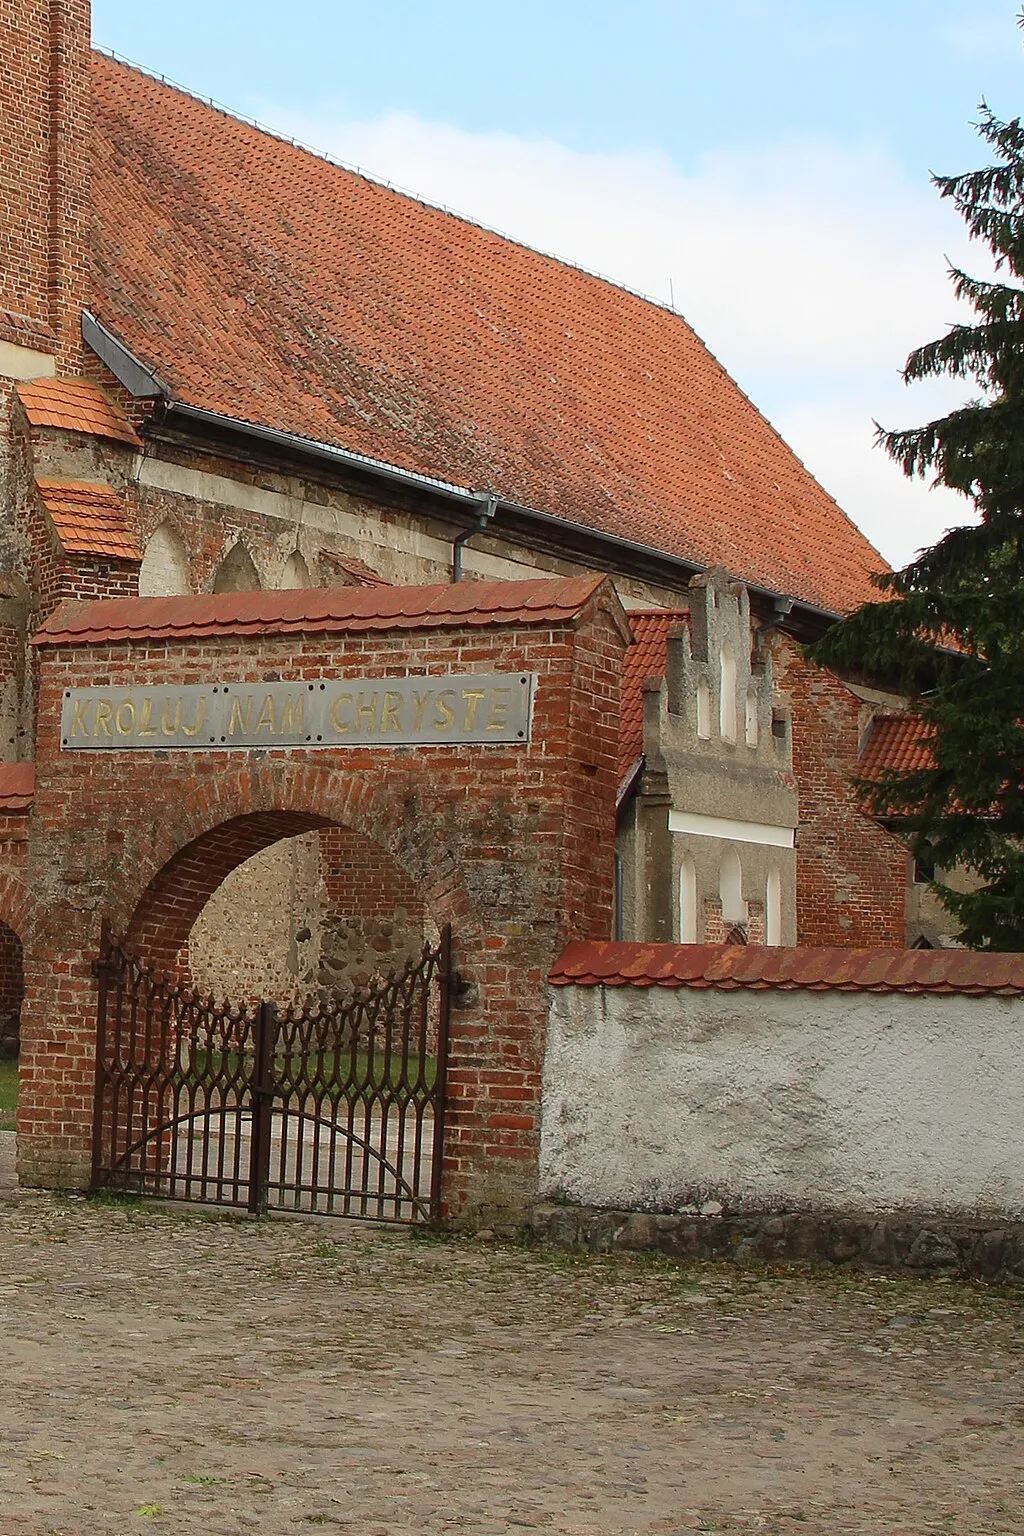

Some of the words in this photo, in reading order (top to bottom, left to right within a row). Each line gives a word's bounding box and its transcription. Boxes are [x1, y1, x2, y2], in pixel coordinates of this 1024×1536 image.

[70, 688, 206, 737] KRÓLUJ
[228, 693, 305, 736] NAM
[330, 687, 512, 733] CHRYSTE
